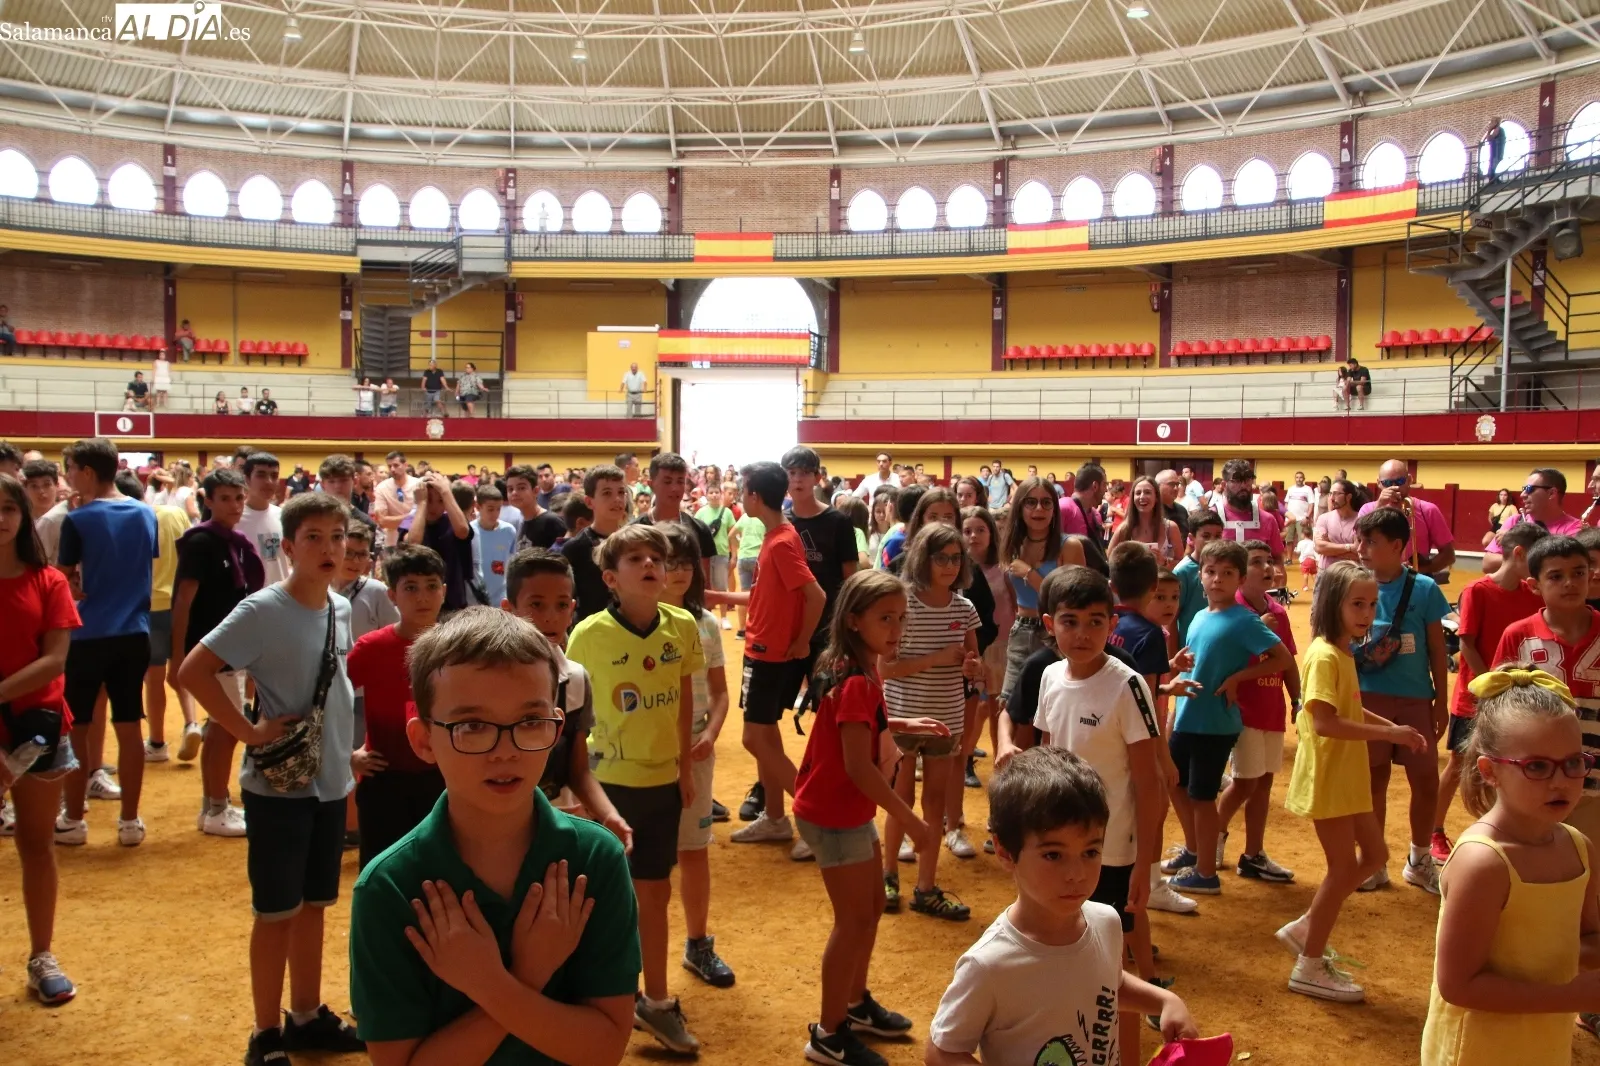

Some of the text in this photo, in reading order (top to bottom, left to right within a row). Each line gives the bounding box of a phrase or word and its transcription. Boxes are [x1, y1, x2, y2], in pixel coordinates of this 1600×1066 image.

[1542, 96, 1550, 108] 4
[1342, 134, 1348, 145] 4
[1165, 157, 1170, 166] 4
[669, 176, 676, 185] 4
[995, 171, 1001, 180] 4
[1341, 278, 1347, 288] 7
[1163, 289, 1169, 299] 7
[995, 296, 1001, 305] 7
[1159, 424, 1167, 438] 7
[1091, 985, 1116, 1066] GRRRR!
